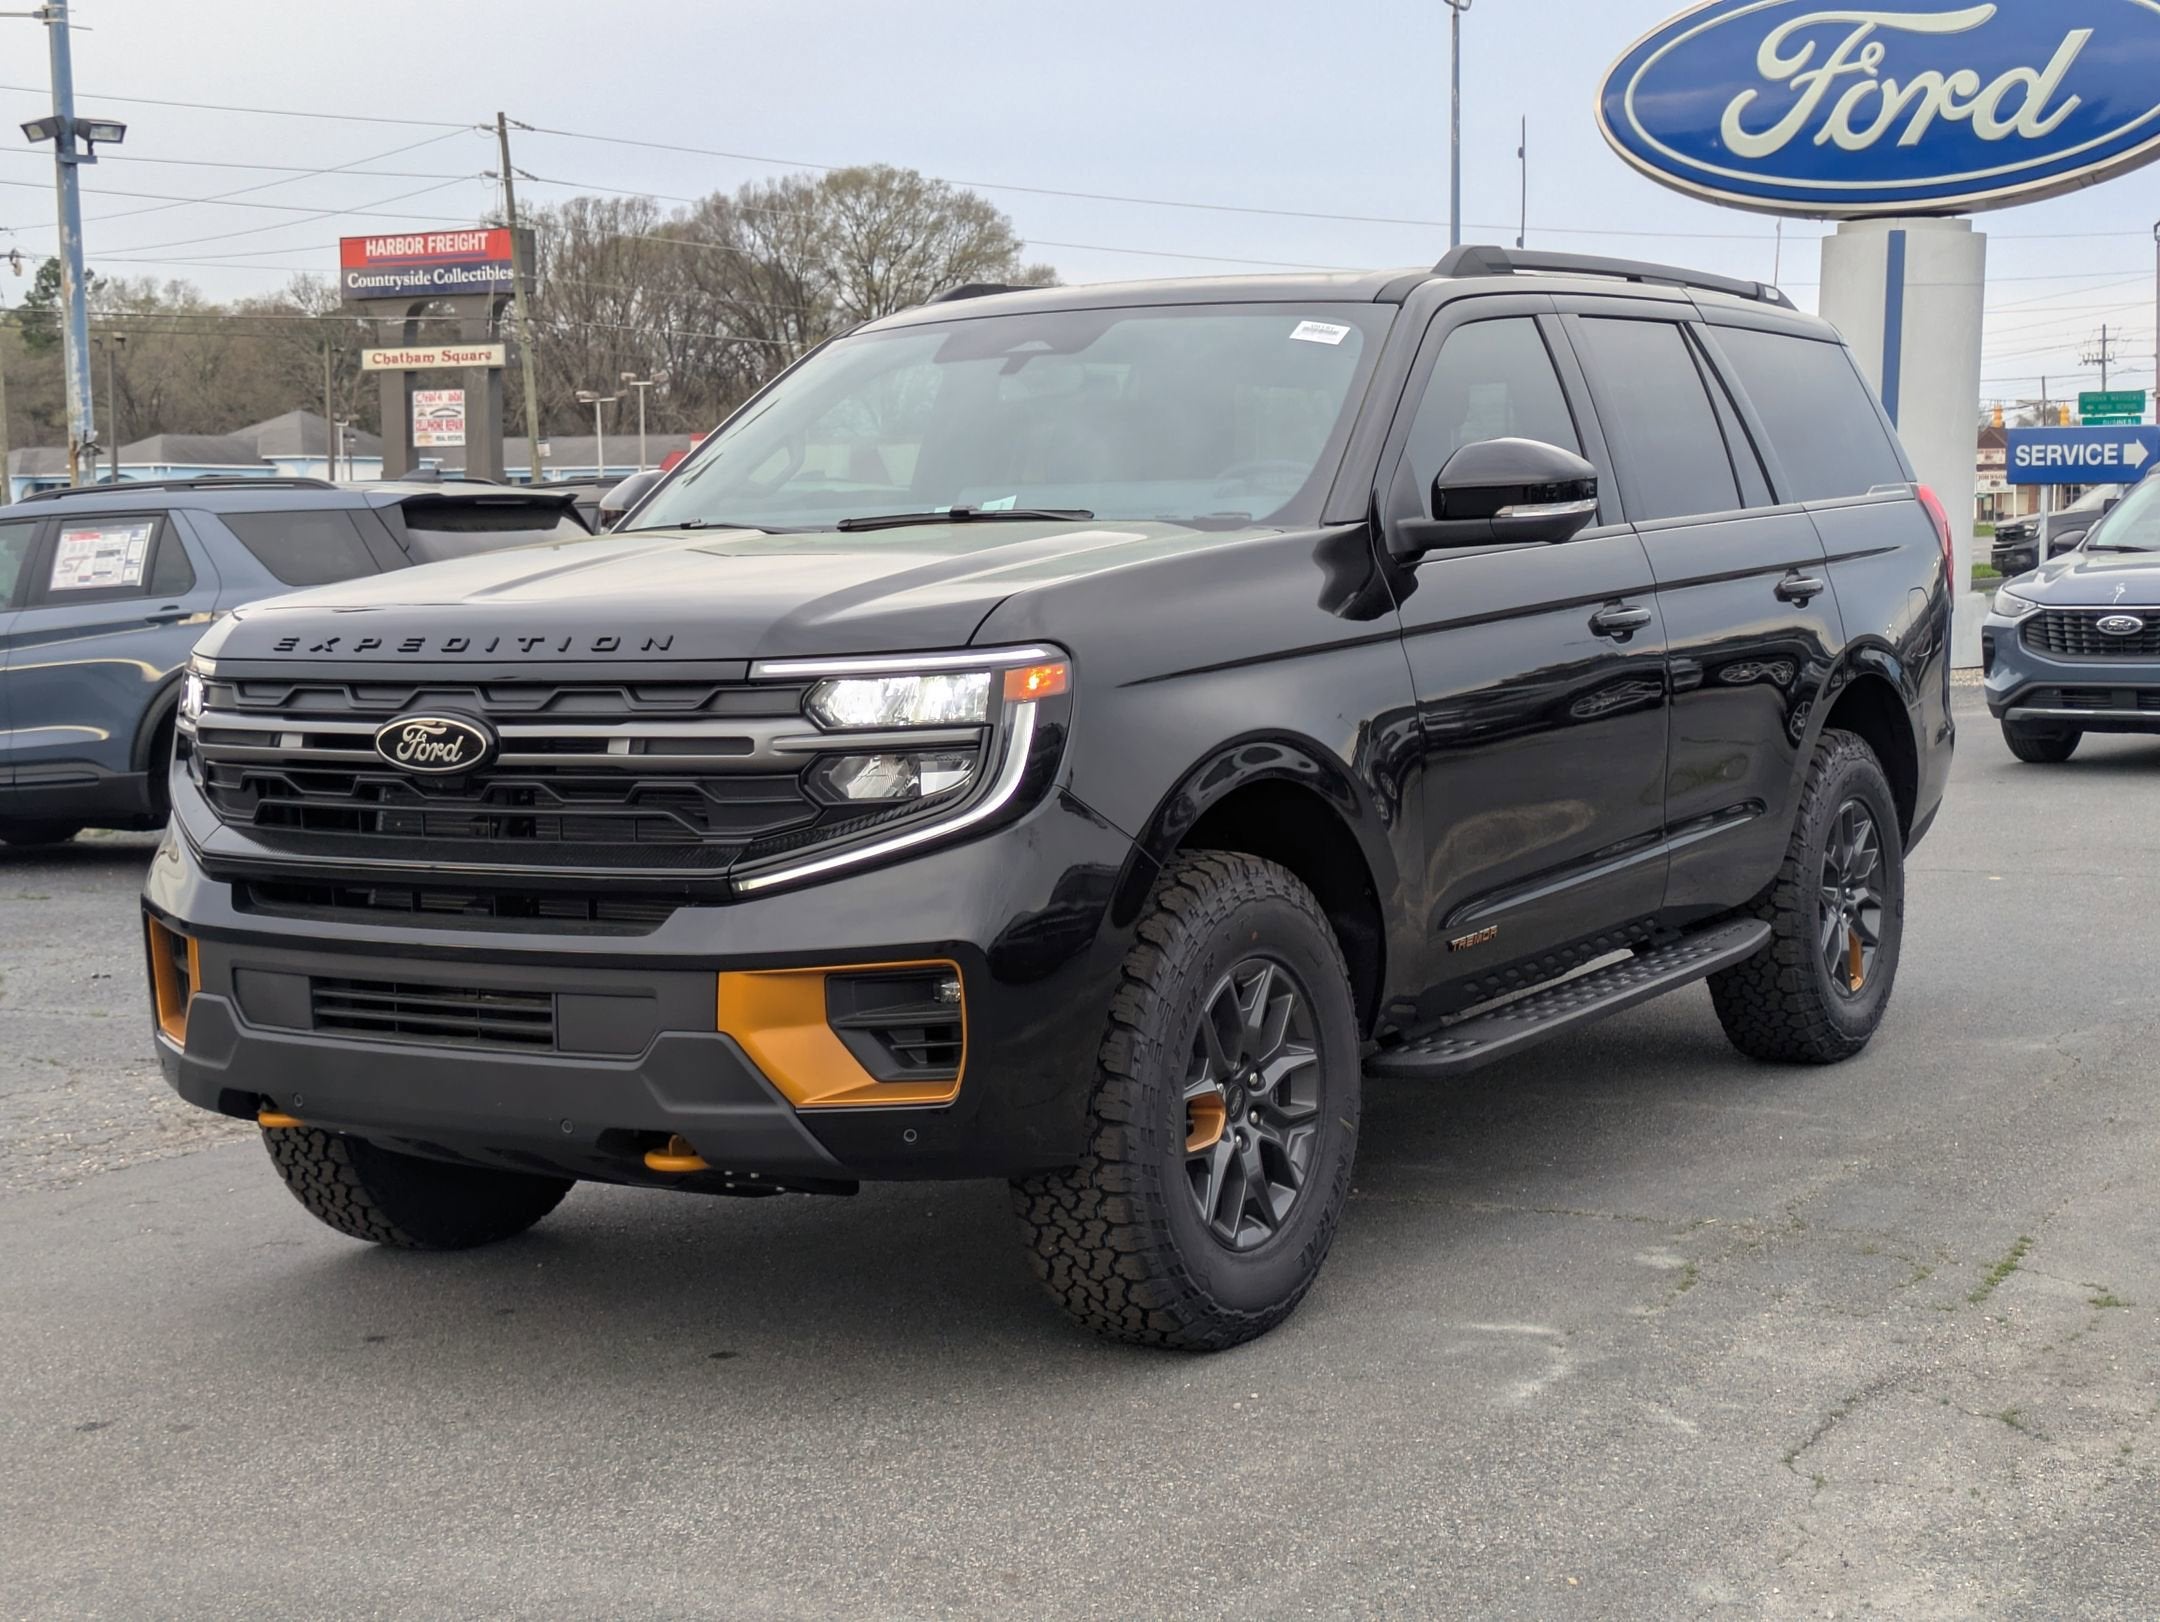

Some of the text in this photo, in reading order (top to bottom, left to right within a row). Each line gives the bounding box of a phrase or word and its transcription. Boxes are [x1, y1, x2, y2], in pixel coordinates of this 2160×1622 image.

[1721, 3, 2094, 159] Ford
[366, 232, 489, 257] HARBOR FREIGHT
[348, 265, 514, 290] Countryside Collectibles
[372, 350, 493, 365] Chatham Square
[2015, 443, 2119, 467] SERVICE
[273, 634, 675, 653] EXPEDITION
[396, 722, 464, 763] Ford
[1450, 924, 1498, 952] TREMOR
